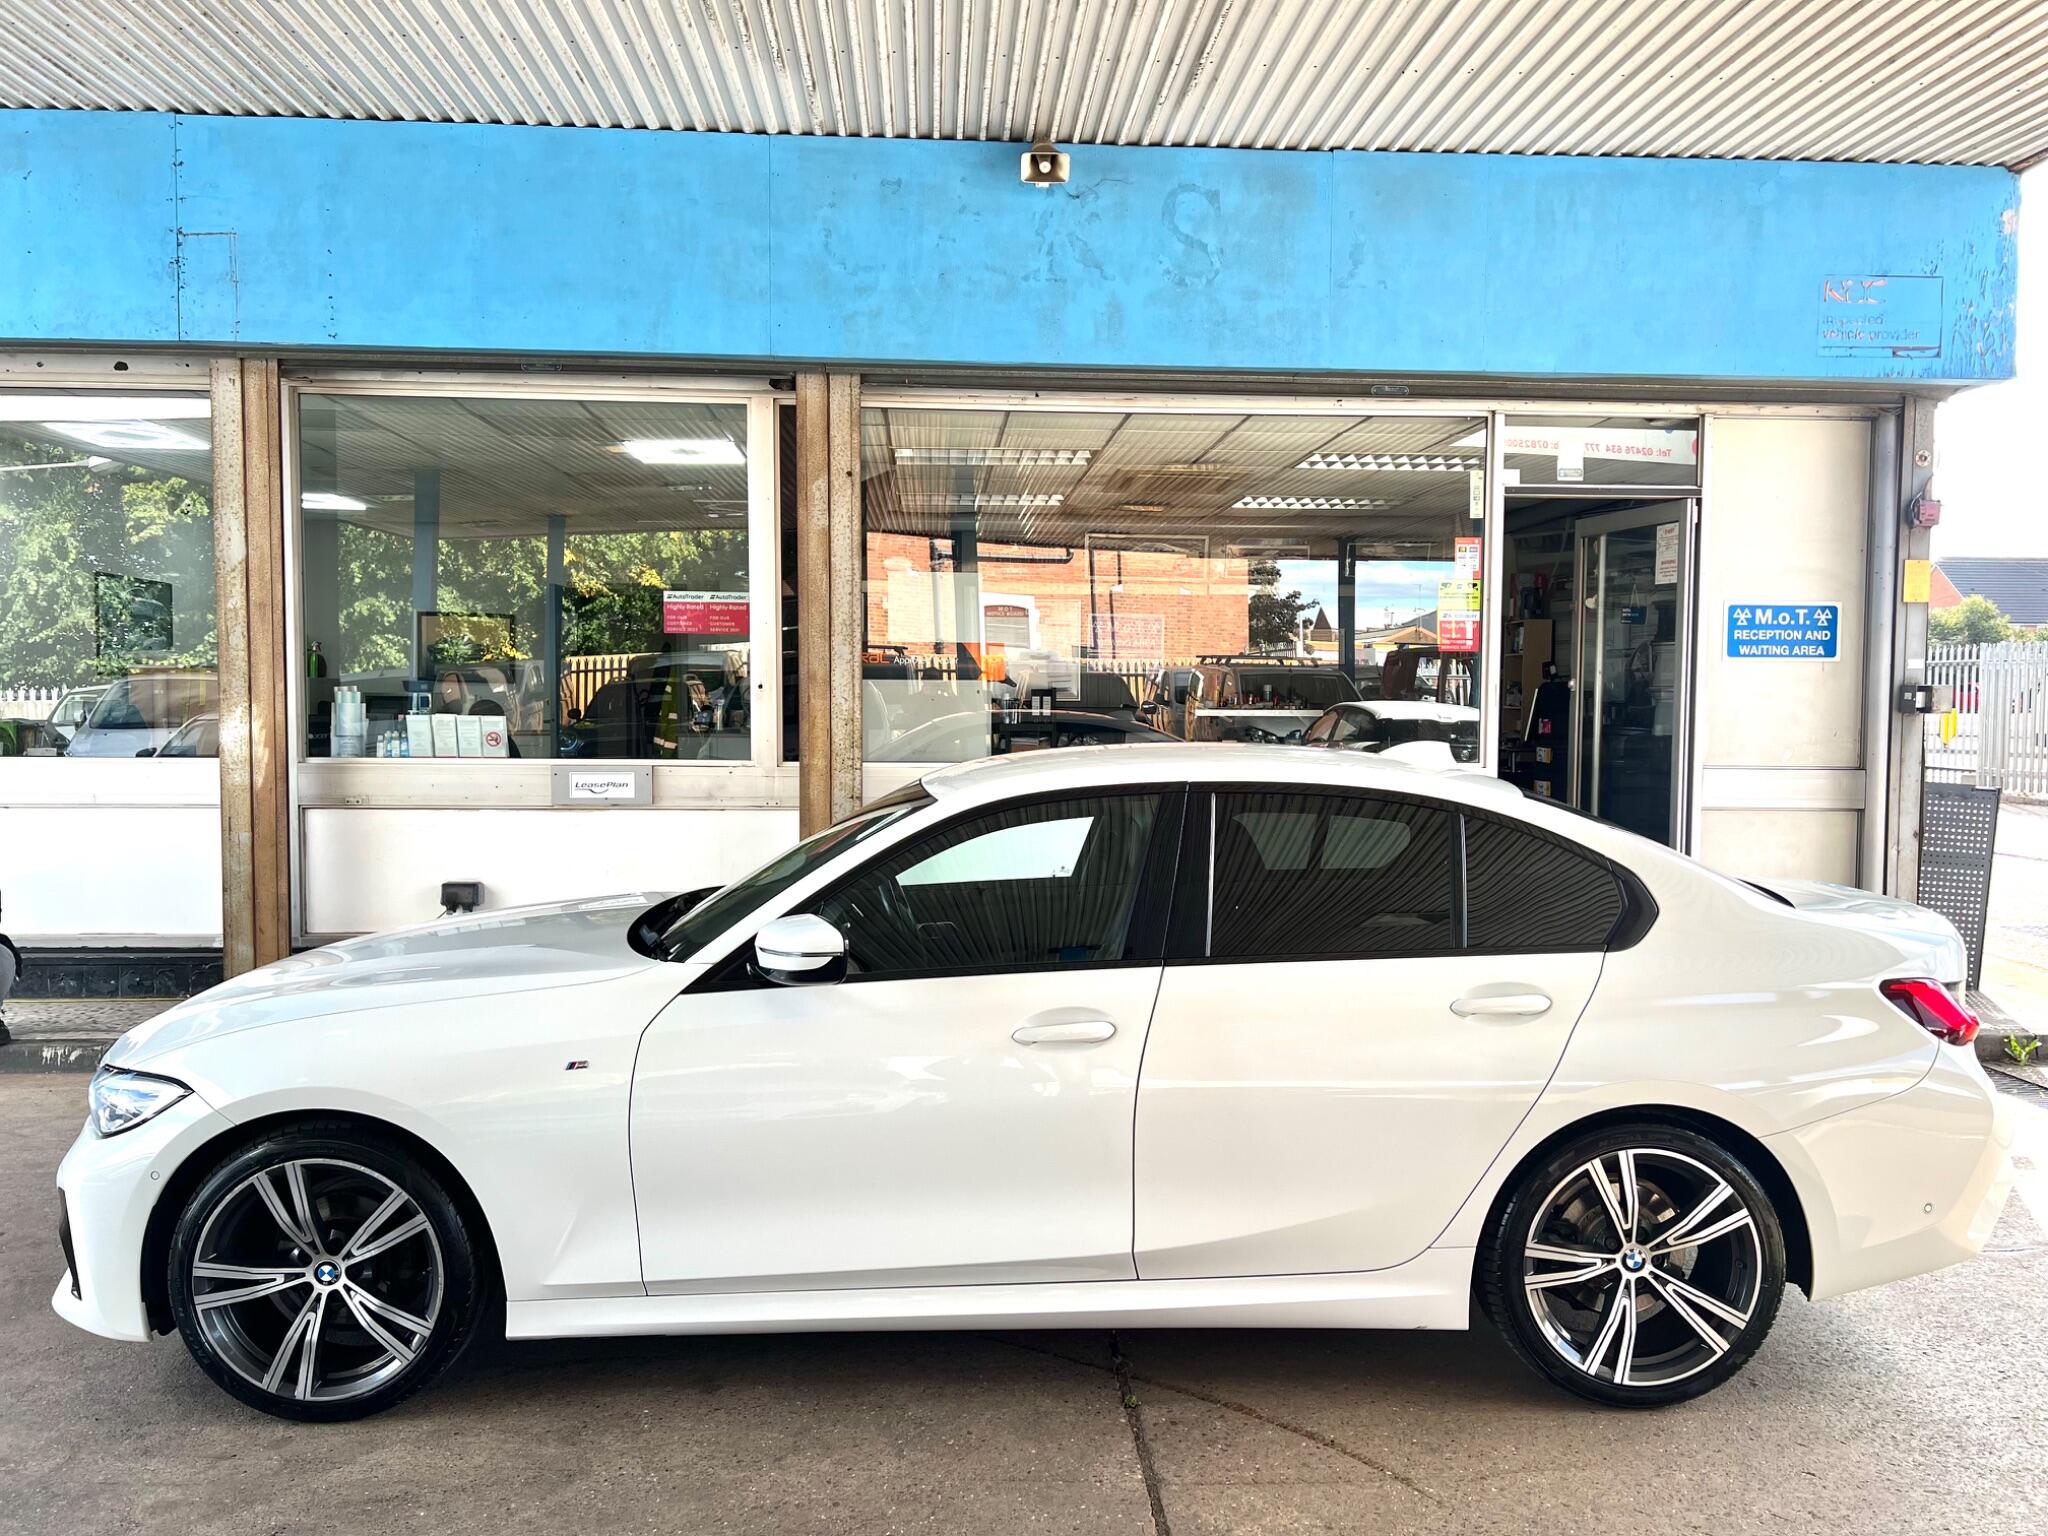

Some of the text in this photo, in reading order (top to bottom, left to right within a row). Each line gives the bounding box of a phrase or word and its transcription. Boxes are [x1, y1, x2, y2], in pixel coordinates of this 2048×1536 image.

[1755, 608, 1810, 625] M.o.T.
[1734, 630, 1831, 640] RECEPTION AND
[1739, 645, 1825, 656] WAITING AREA
